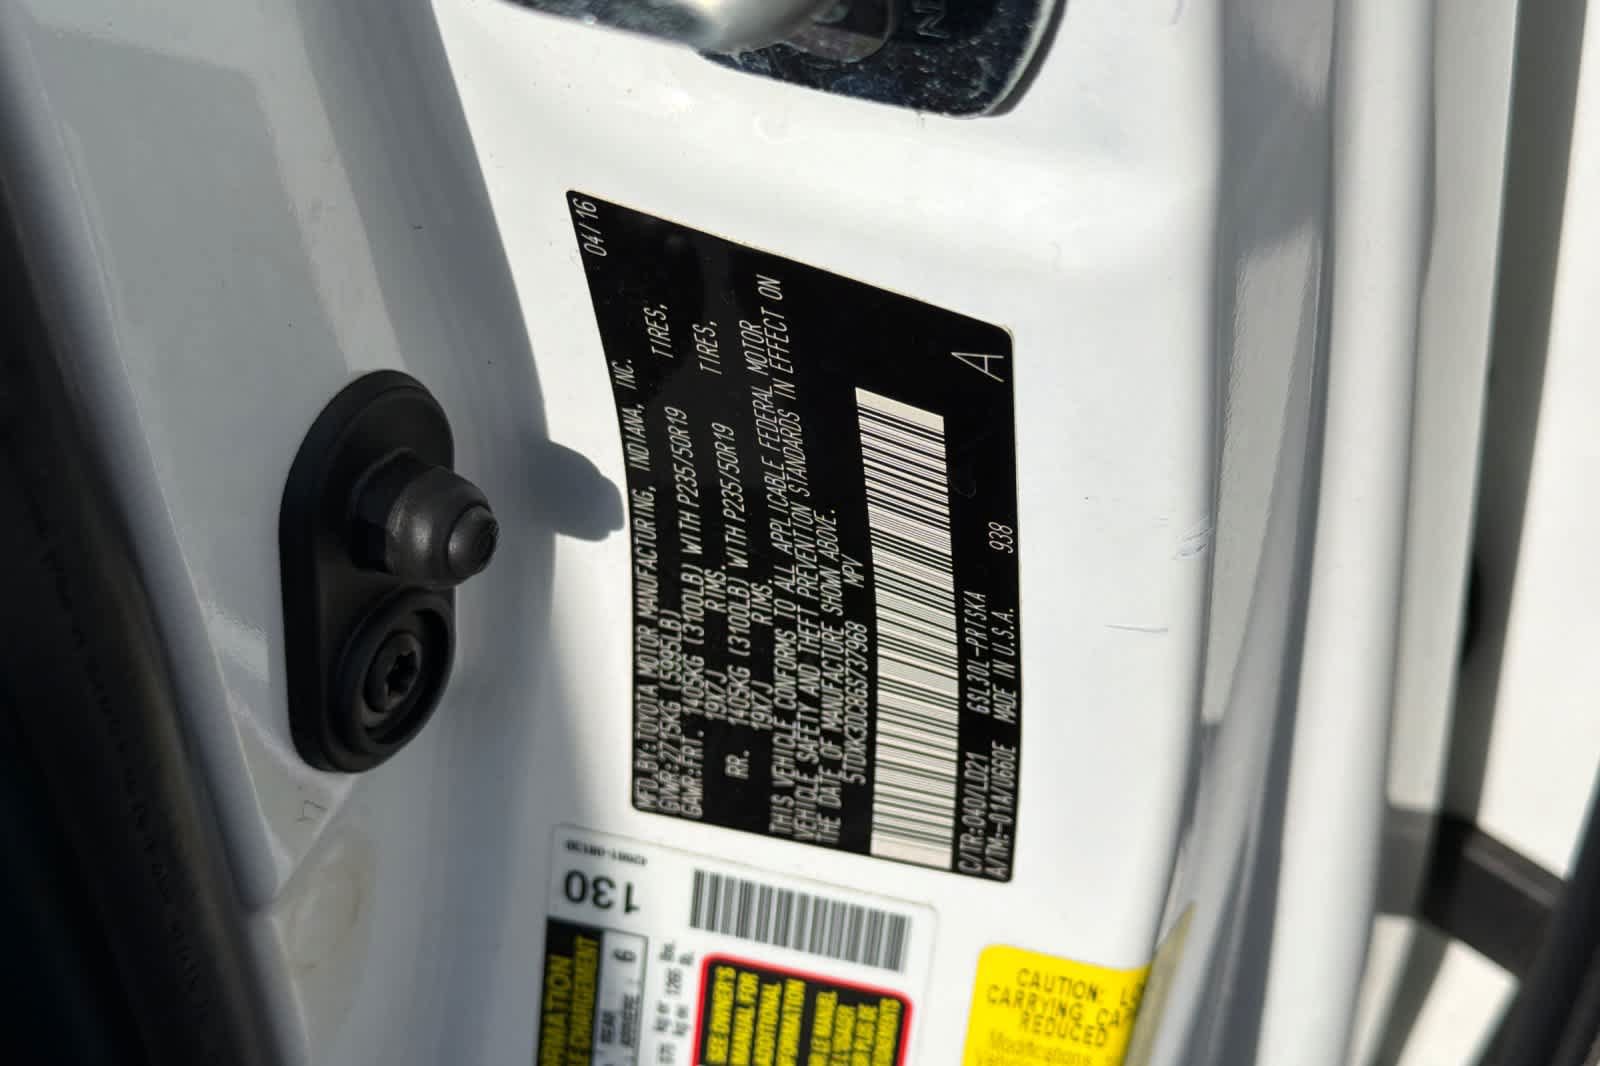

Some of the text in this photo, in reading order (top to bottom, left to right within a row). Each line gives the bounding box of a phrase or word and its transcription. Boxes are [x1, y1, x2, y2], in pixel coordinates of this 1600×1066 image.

[573, 198, 607, 256] 04/16
[643, 304, 674, 359] TIRES,
[611, 359, 637, 390] INC.
[950, 352, 1004, 383] A
[622, 403, 651, 471] INDIANA,
[664, 406, 700, 508] P235/50R19
[632, 486, 658, 620] MANUFACTURING,
[678, 510, 703, 555] WITH
[692, 321, 750, 779] RR. 1405KG (3100LB) WITH P235/50R19 TIRES,
[756, 274, 820, 840] VEHICLE SAFETY AND THEFT PREVENTION STANDARDS IN EFFECT ON
[988, 521, 1014, 554] 938
[681, 563, 704, 645] (3100LB)
[739, 320, 797, 834] THIS VEHICLE CONFORMS TO ALL APPLICABLE FEDERAL MOTOR
[637, 625, 659, 678] MOTOR
[659, 609, 682, 691] (5995LB)
[704, 564, 727, 720] 19X7J RIMS.
[750, 579, 773, 730] 19X7J RIMS.
[991, 608, 1015, 656] U.S.A.
[682, 653, 704, 716] 1405KG
[813, 510, 844, 843] THE DATE OF MANUFACTURE SHOWN ABOVE.
[841, 553, 868, 785] 5TDXK3DC8GS737968 MPV
[992, 659, 1016, 679] IN
[993, 684, 1016, 724] MADE
[564, 869, 639, 916] 130
[986, 984, 1083, 1023] CARRYING
[1021, 1010, 1108, 1048] REDUCED
